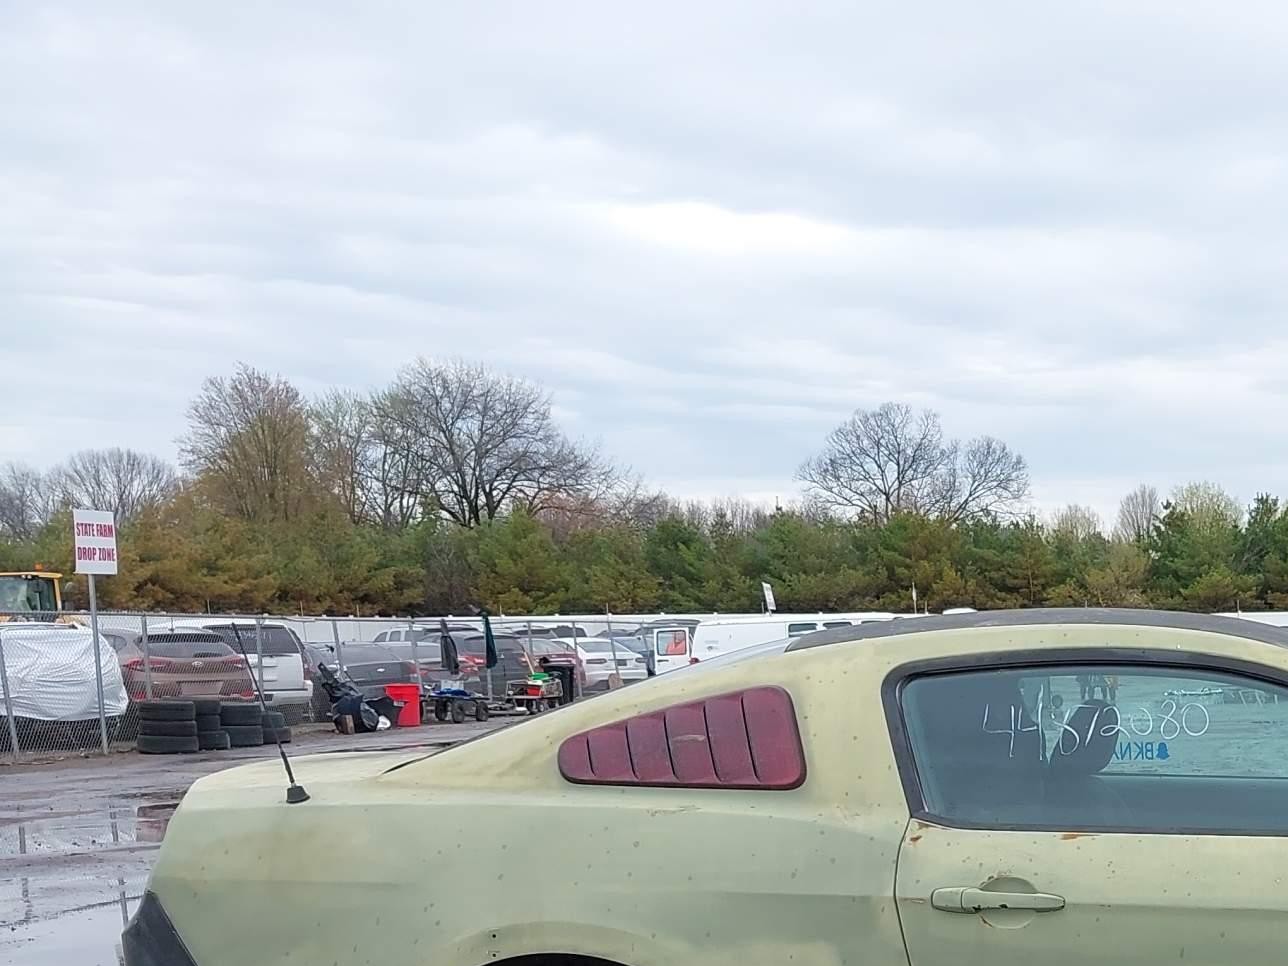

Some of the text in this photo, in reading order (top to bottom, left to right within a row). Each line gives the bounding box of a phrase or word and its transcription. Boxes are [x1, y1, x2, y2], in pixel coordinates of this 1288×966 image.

[76, 522, 113, 538] STATE FARM
[77, 546, 115, 562] DROP ZONE
[982, 684, 1209, 761] 44872080
